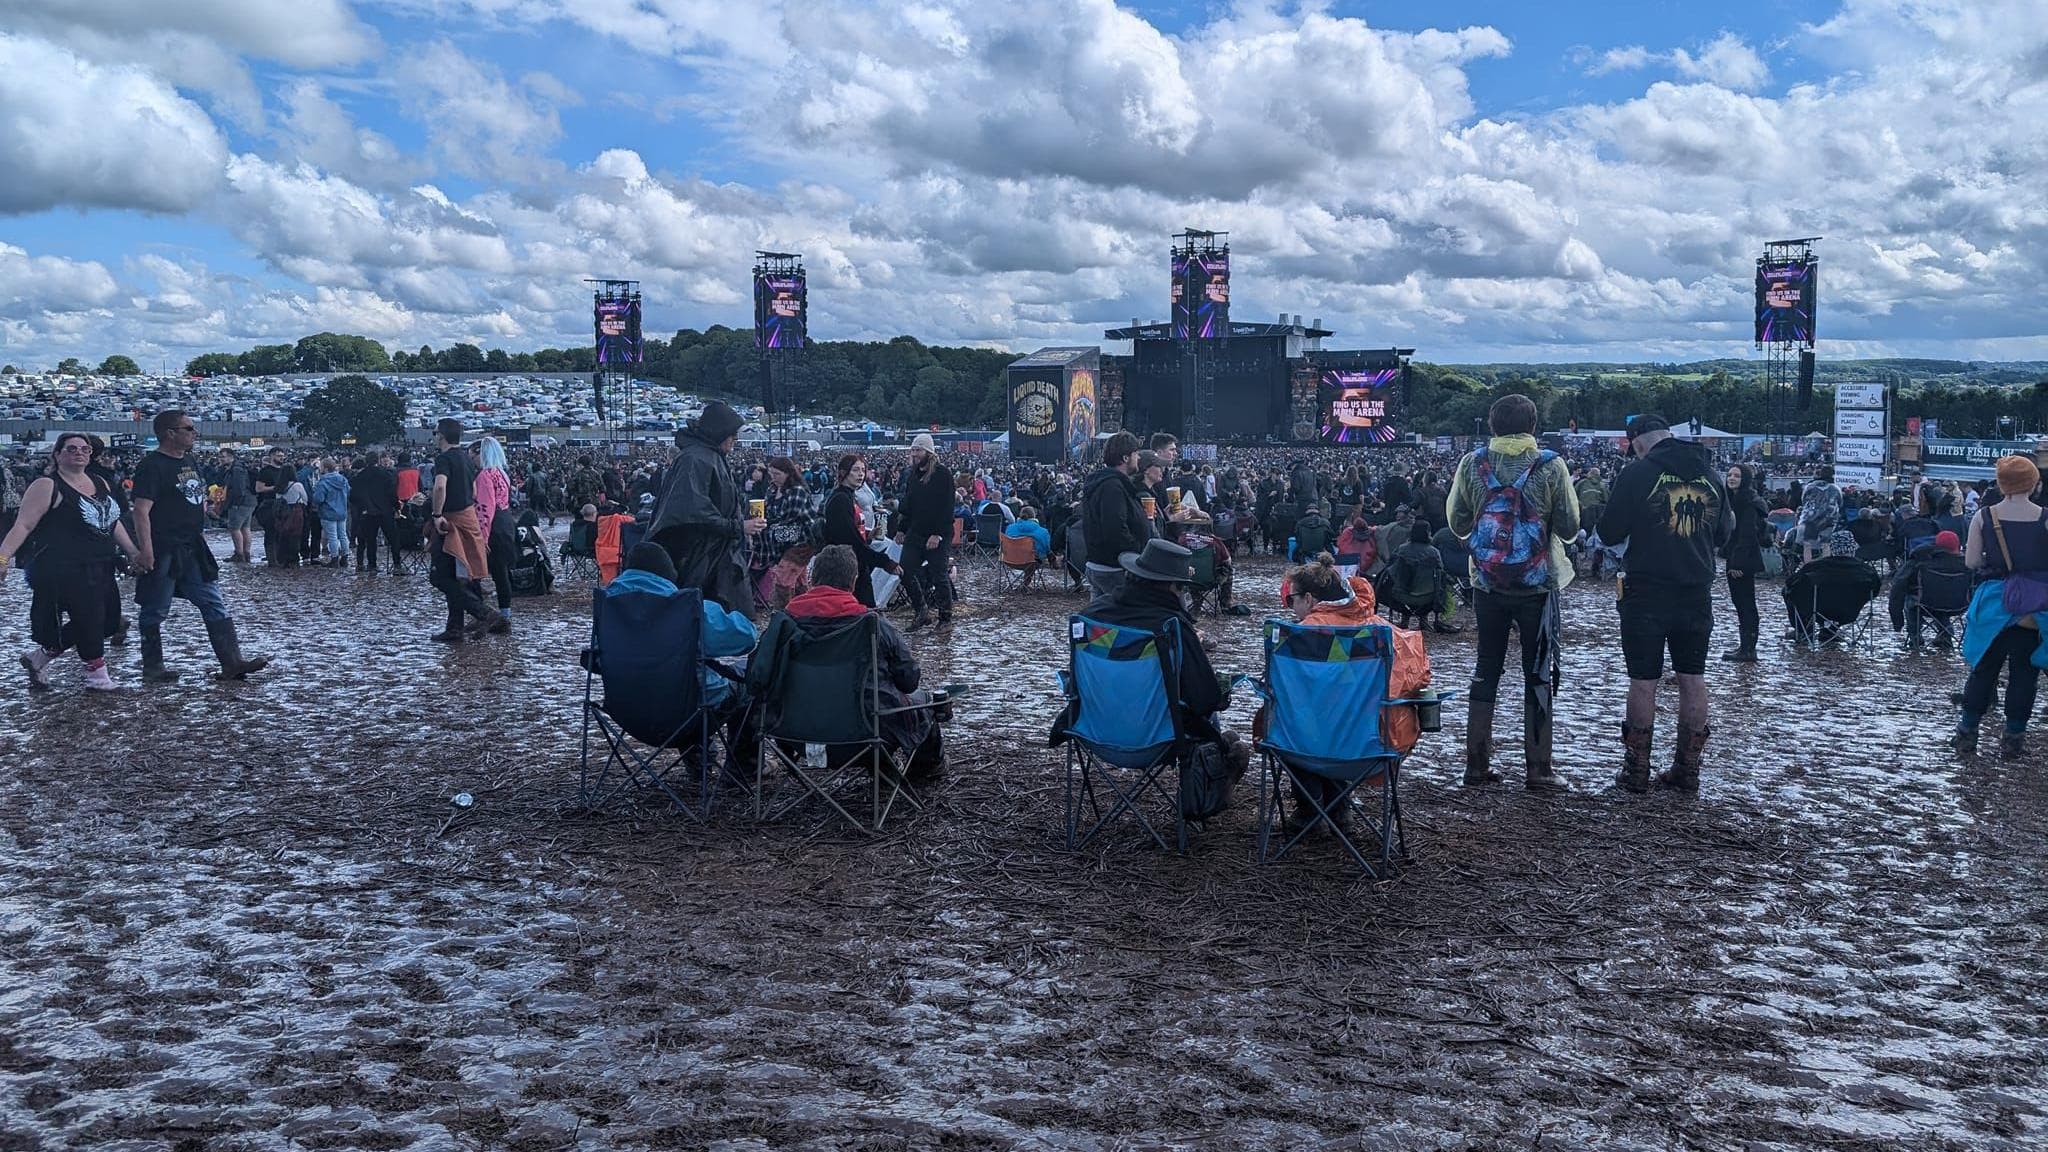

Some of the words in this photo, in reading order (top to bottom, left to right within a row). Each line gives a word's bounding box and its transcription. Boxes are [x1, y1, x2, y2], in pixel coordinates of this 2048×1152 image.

[1014, 381, 1036, 404] LIQUID
[1037, 381, 1059, 405] DEATH
[1357, 408, 1385, 416] ARENA
[1016, 421, 1057, 436] DOWNLOAD
[1928, 445, 1965, 456] WHITBY
[1967, 446, 1990, 458] FISH
[1991, 448, 1999, 458] &
